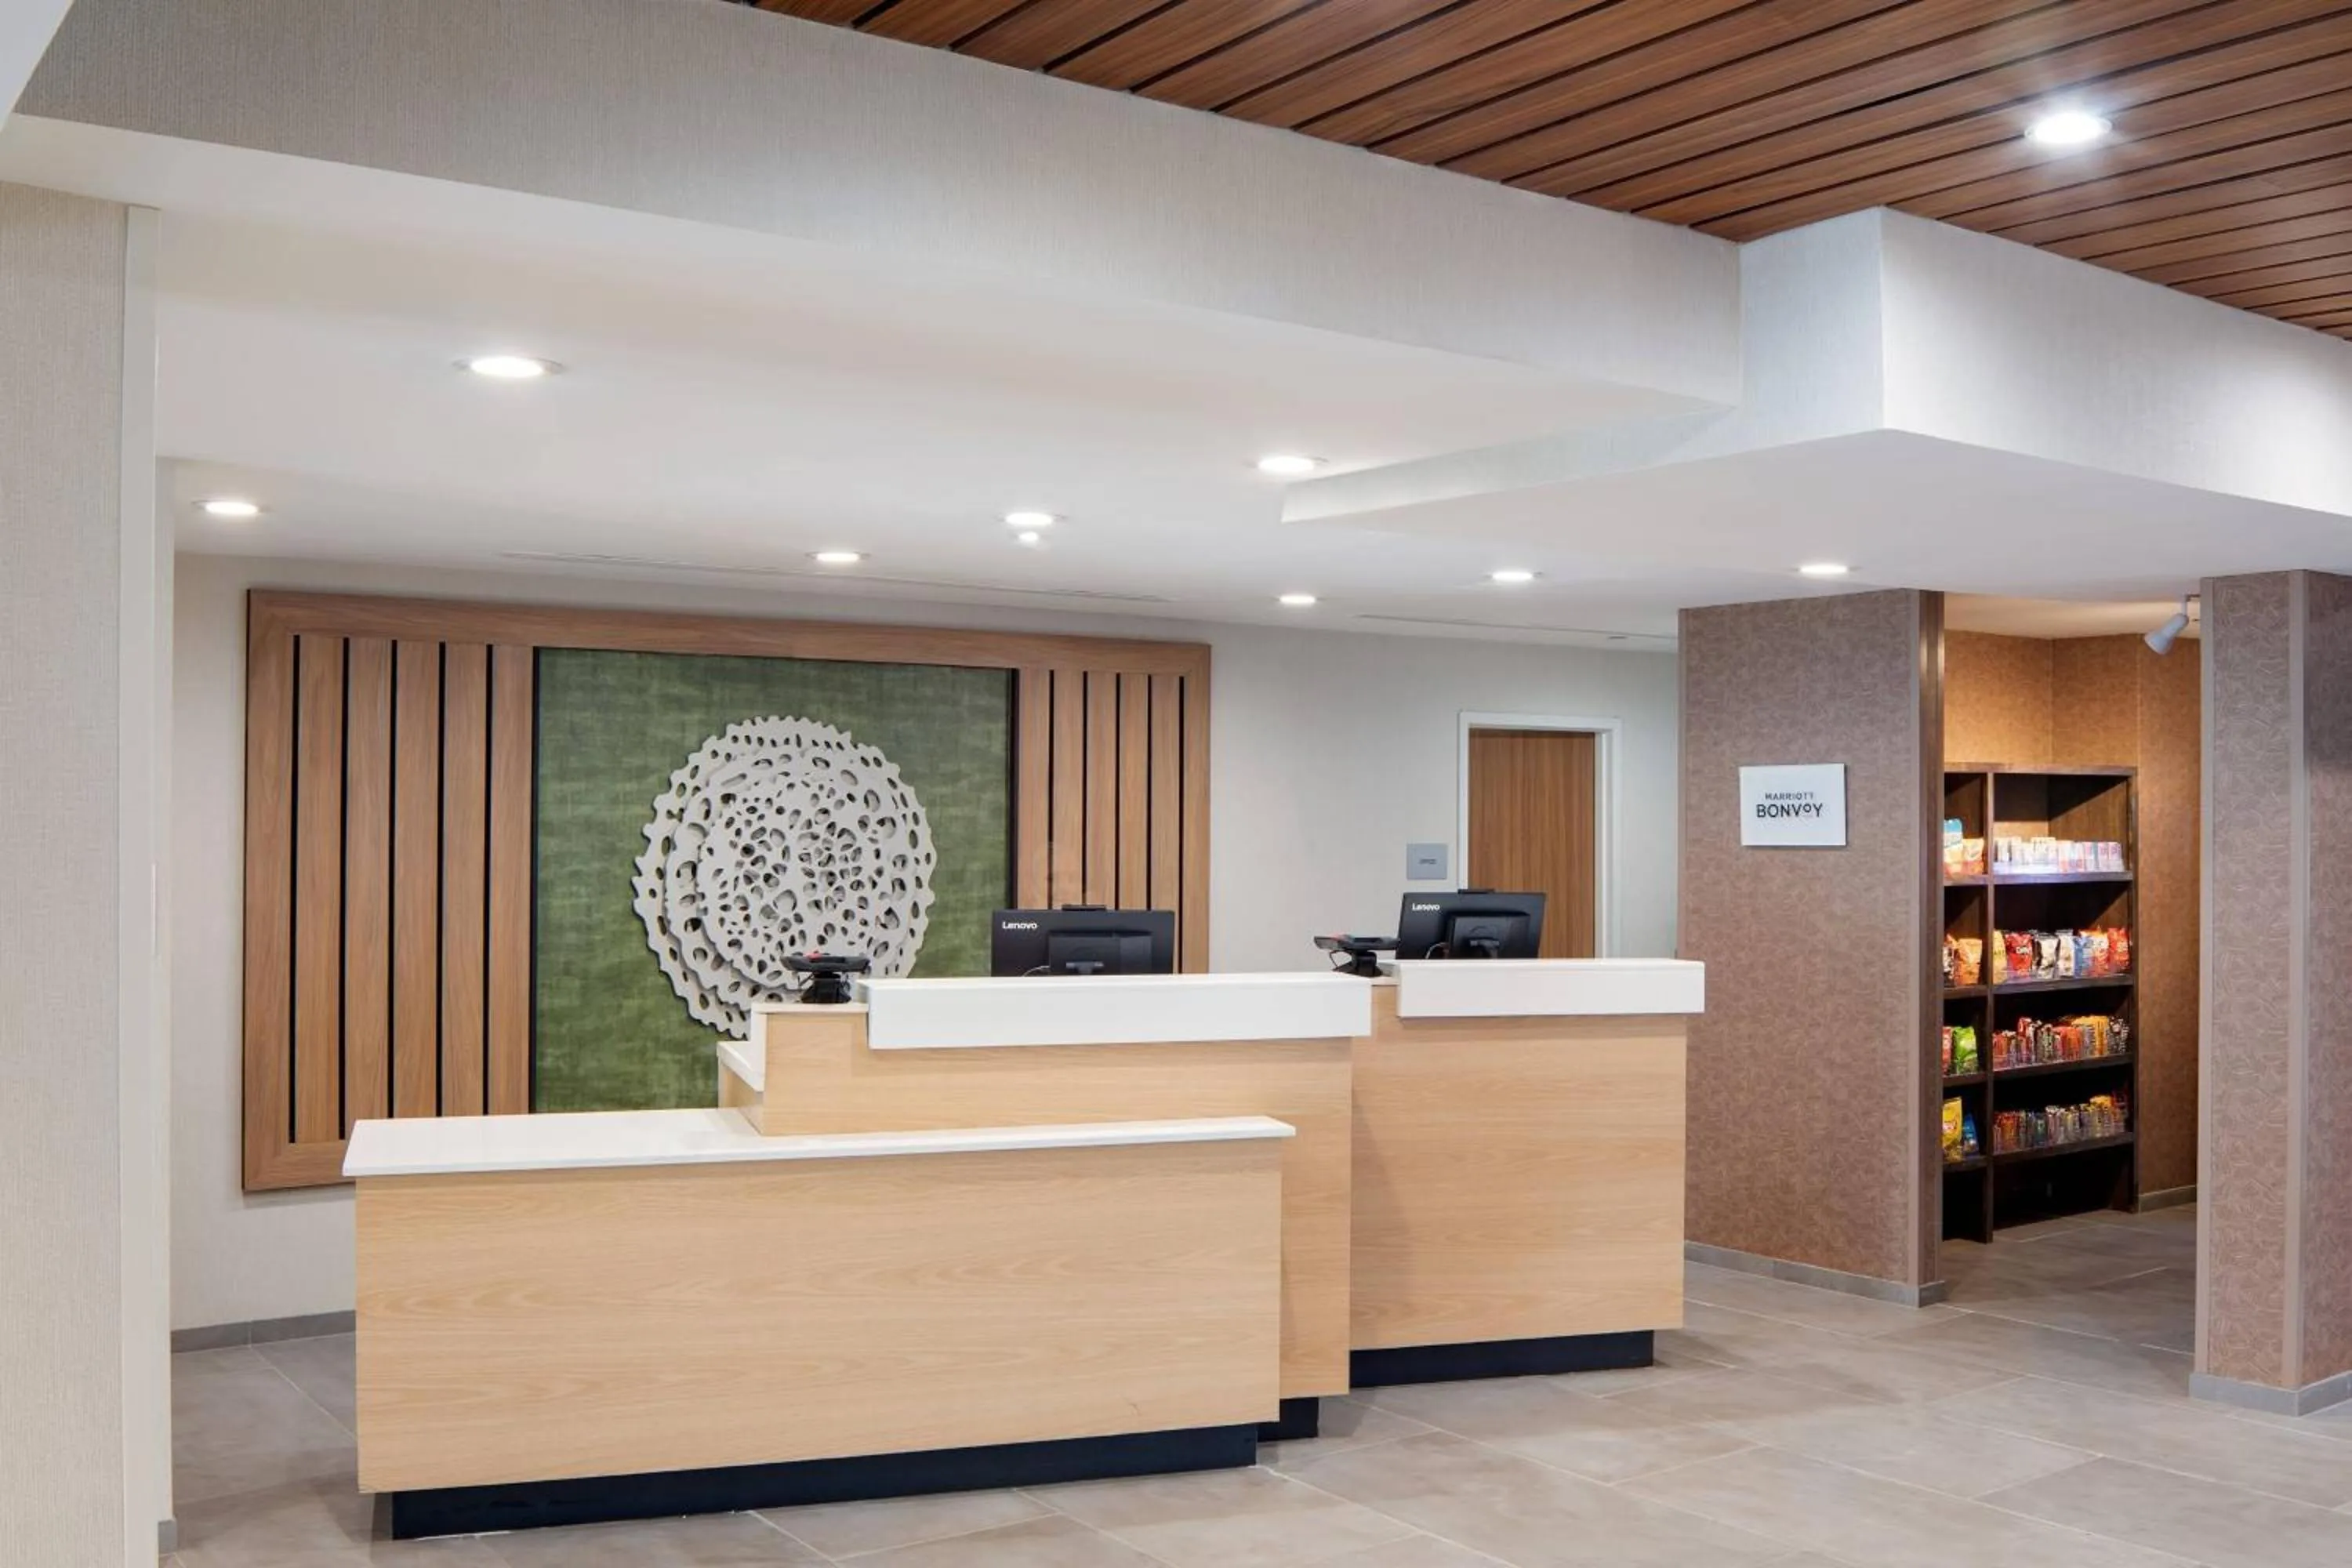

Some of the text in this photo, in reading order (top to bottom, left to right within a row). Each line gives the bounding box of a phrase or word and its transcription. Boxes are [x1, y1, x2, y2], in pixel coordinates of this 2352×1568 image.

[1765, 792, 1814, 800] MARRIOTT
[1756, 803, 1823, 818] BONVOY
[1411, 902, 1440, 911] Lenovo
[1003, 921, 1038, 930] Lenovo
